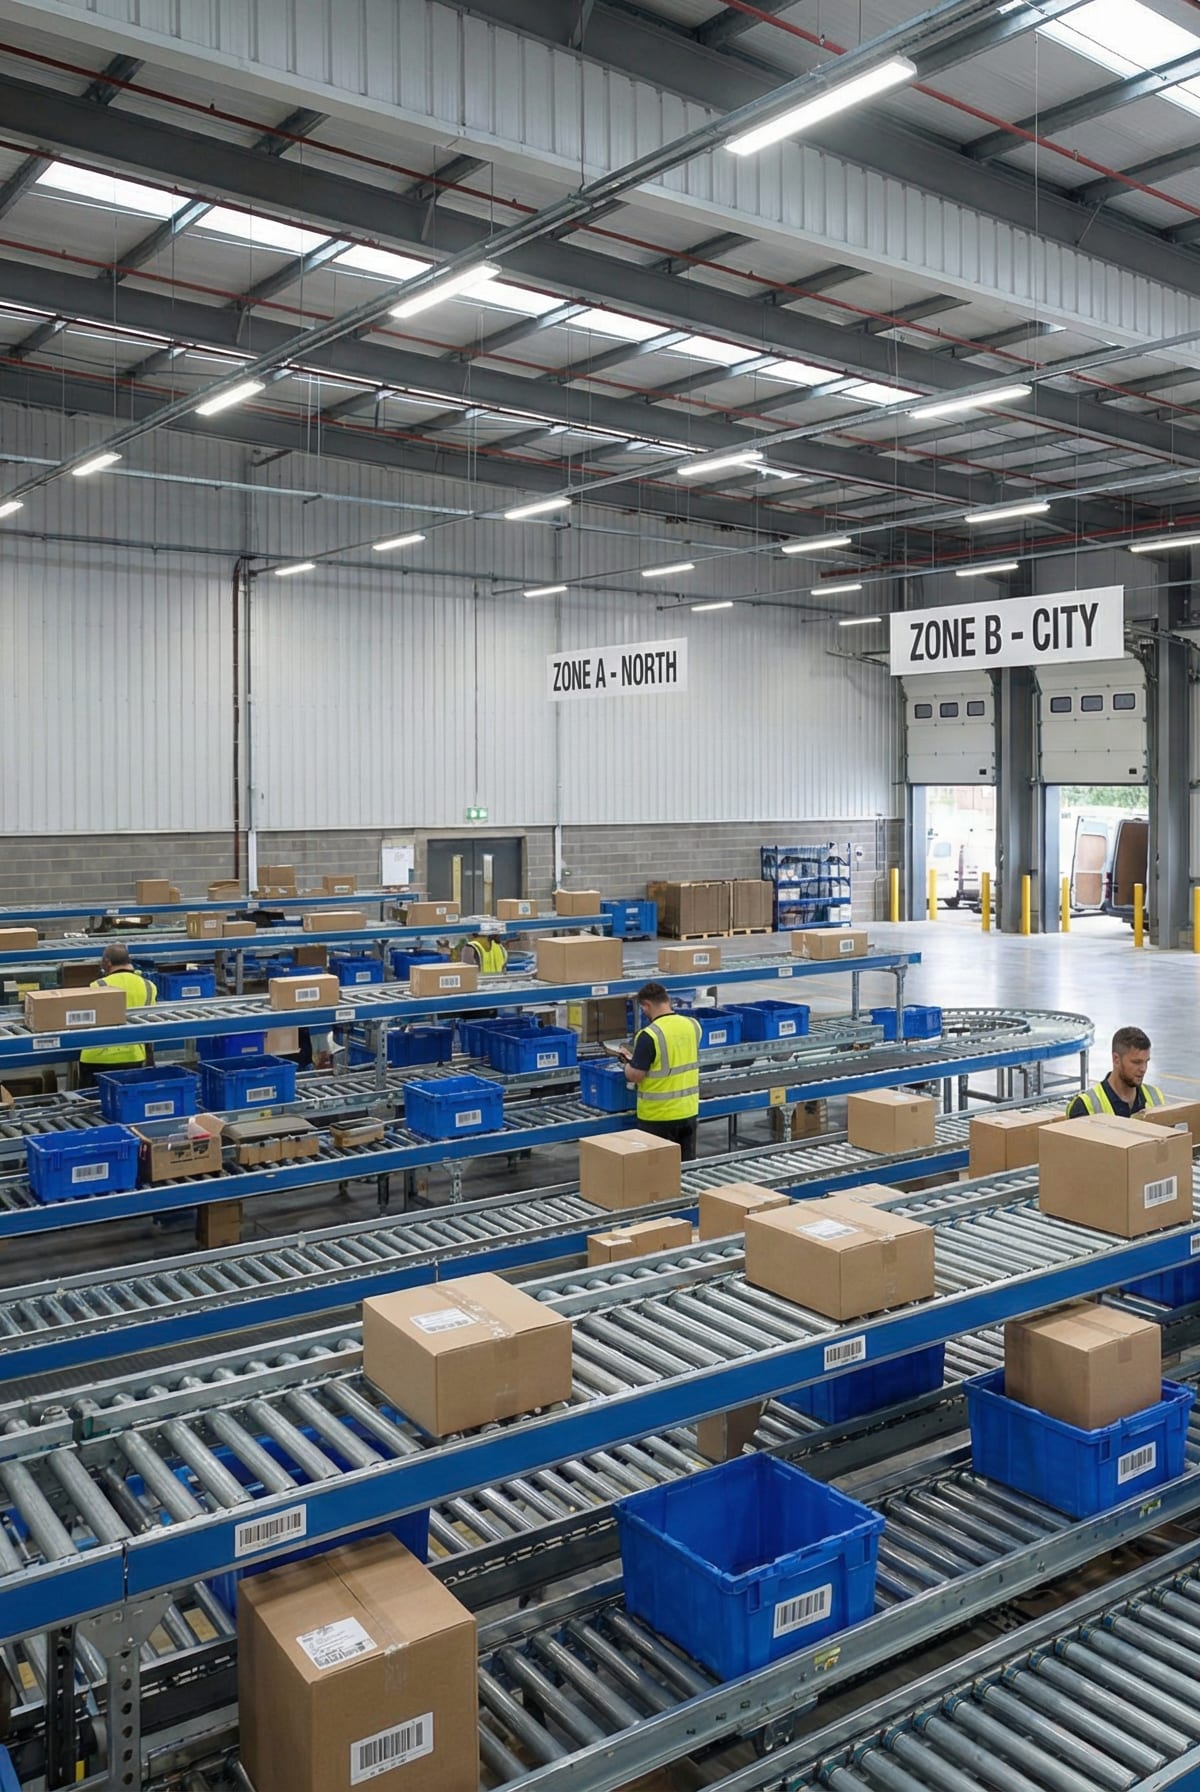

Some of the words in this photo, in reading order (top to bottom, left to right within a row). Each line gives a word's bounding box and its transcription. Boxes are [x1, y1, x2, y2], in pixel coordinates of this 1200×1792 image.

[910, 616, 976, 662] ZONE
[985, 614, 1002, 655] B
[1011, 631, 1024, 641] -
[1032, 602, 1099, 652] CITY
[553, 659, 591, 691] ZONE
[595, 658, 607, 688] A
[621, 650, 677, 686] NORTH
